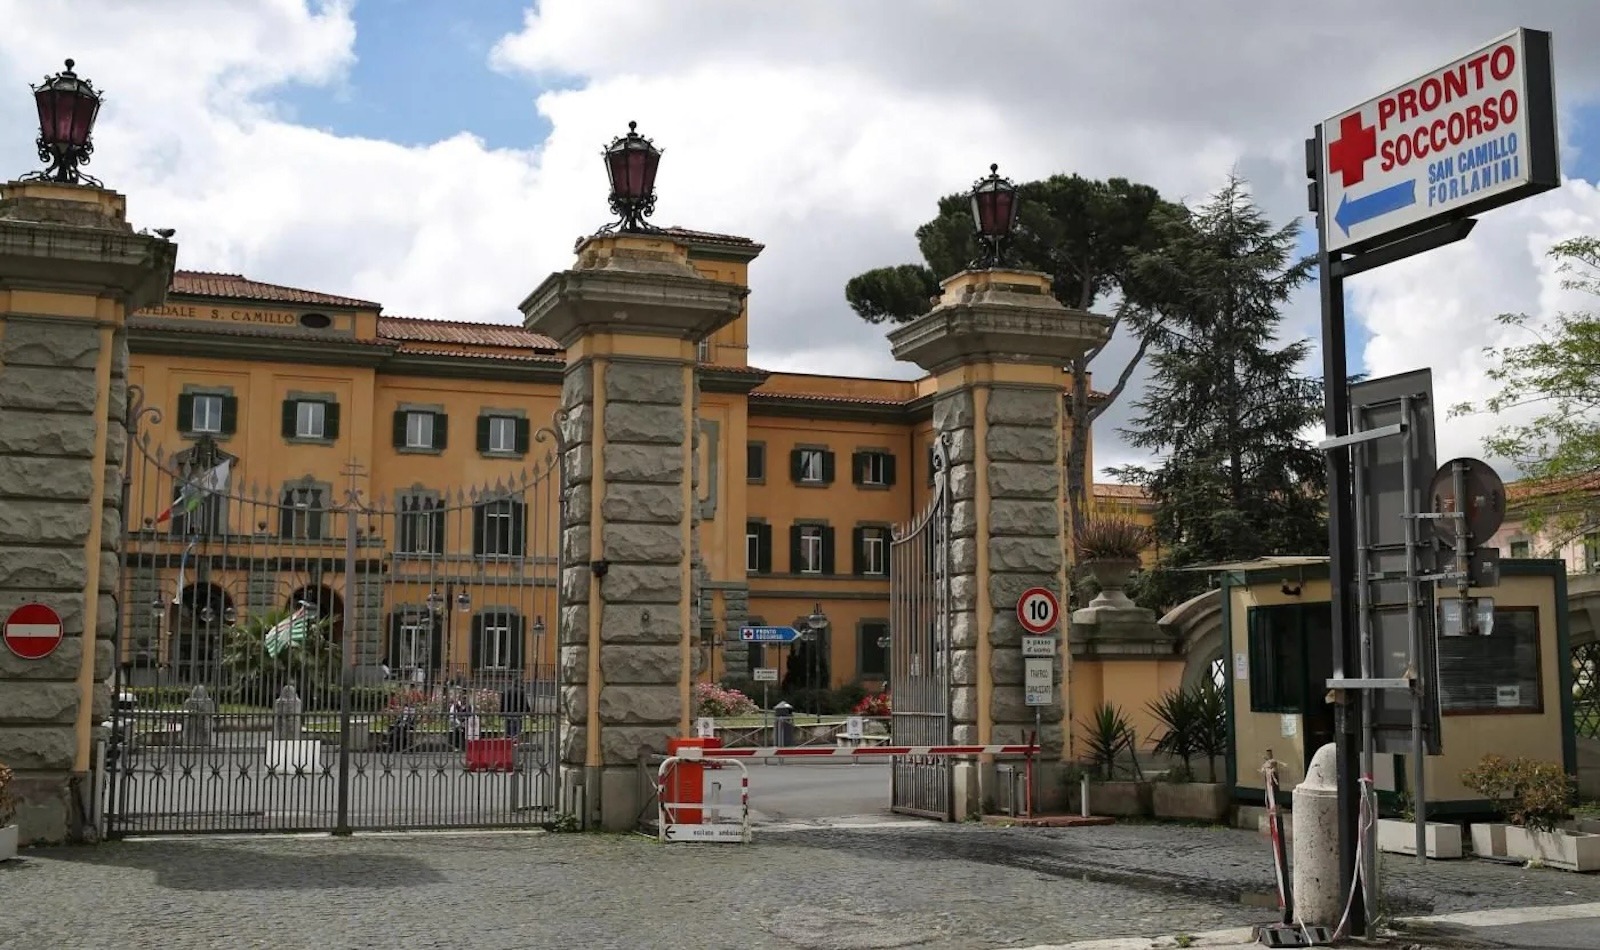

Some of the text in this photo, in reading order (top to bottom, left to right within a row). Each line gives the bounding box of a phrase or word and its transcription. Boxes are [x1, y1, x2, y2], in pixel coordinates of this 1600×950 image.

[1378, 45, 1515, 131] PRONTO
[1381, 89, 1518, 172] SOCCORSO
[1428, 132, 1517, 184] SAN CAMILLO
[1428, 156, 1519, 207] FORLANINI
[211, 310, 225, 320] S.
[231, 310, 295, 325] CAMILLO
[1030, 600, 1048, 620] 10
